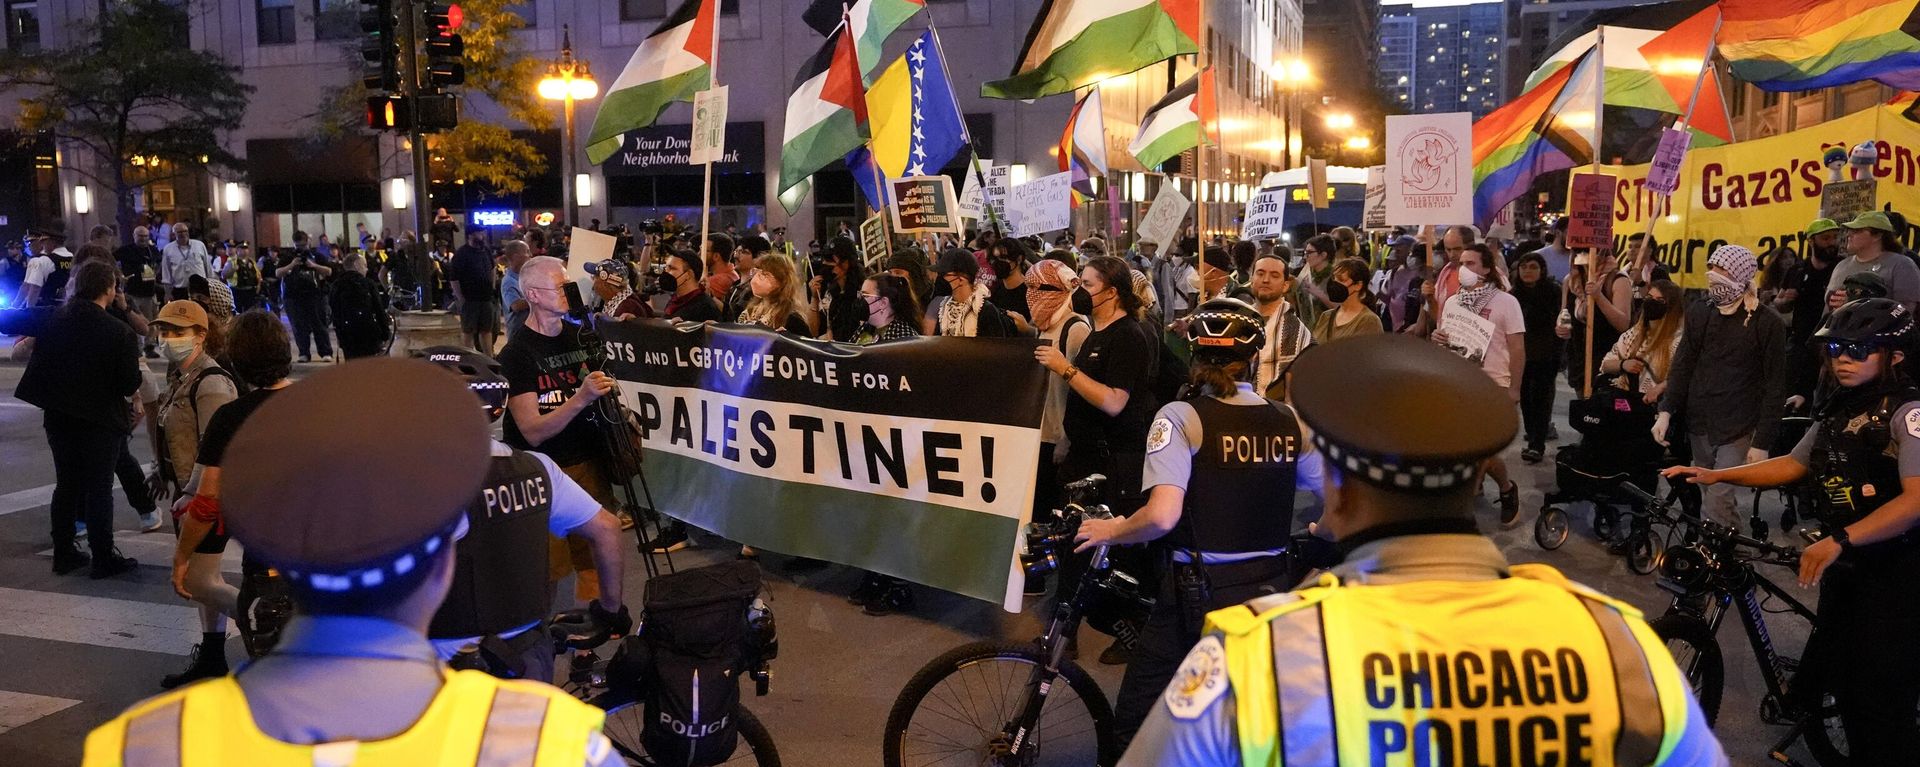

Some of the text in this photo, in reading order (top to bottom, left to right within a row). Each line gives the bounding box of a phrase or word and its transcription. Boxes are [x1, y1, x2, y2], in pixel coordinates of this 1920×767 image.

[623, 152, 690, 167] Neighborho
[635, 136, 661, 150] Your
[1252, 193, 1274, 206] FULL
[1702, 158, 1822, 210] Gaza's
[1249, 202, 1278, 218] LGBTQ
[430, 354, 461, 362] POLICE
[645, 351, 669, 366] AND
[674, 346, 744, 377] LGBTQ+
[750, 353, 839, 386] PEOPLE
[851, 372, 890, 391] FOR
[899, 375, 912, 392] A
[637, 390, 997, 504] PALESTINE!
[1222, 435, 1295, 462] POLICE
[482, 476, 547, 518] POLICE
[1362, 647, 1590, 710] CHICAGO
[1367, 713, 1593, 767] POLICE
